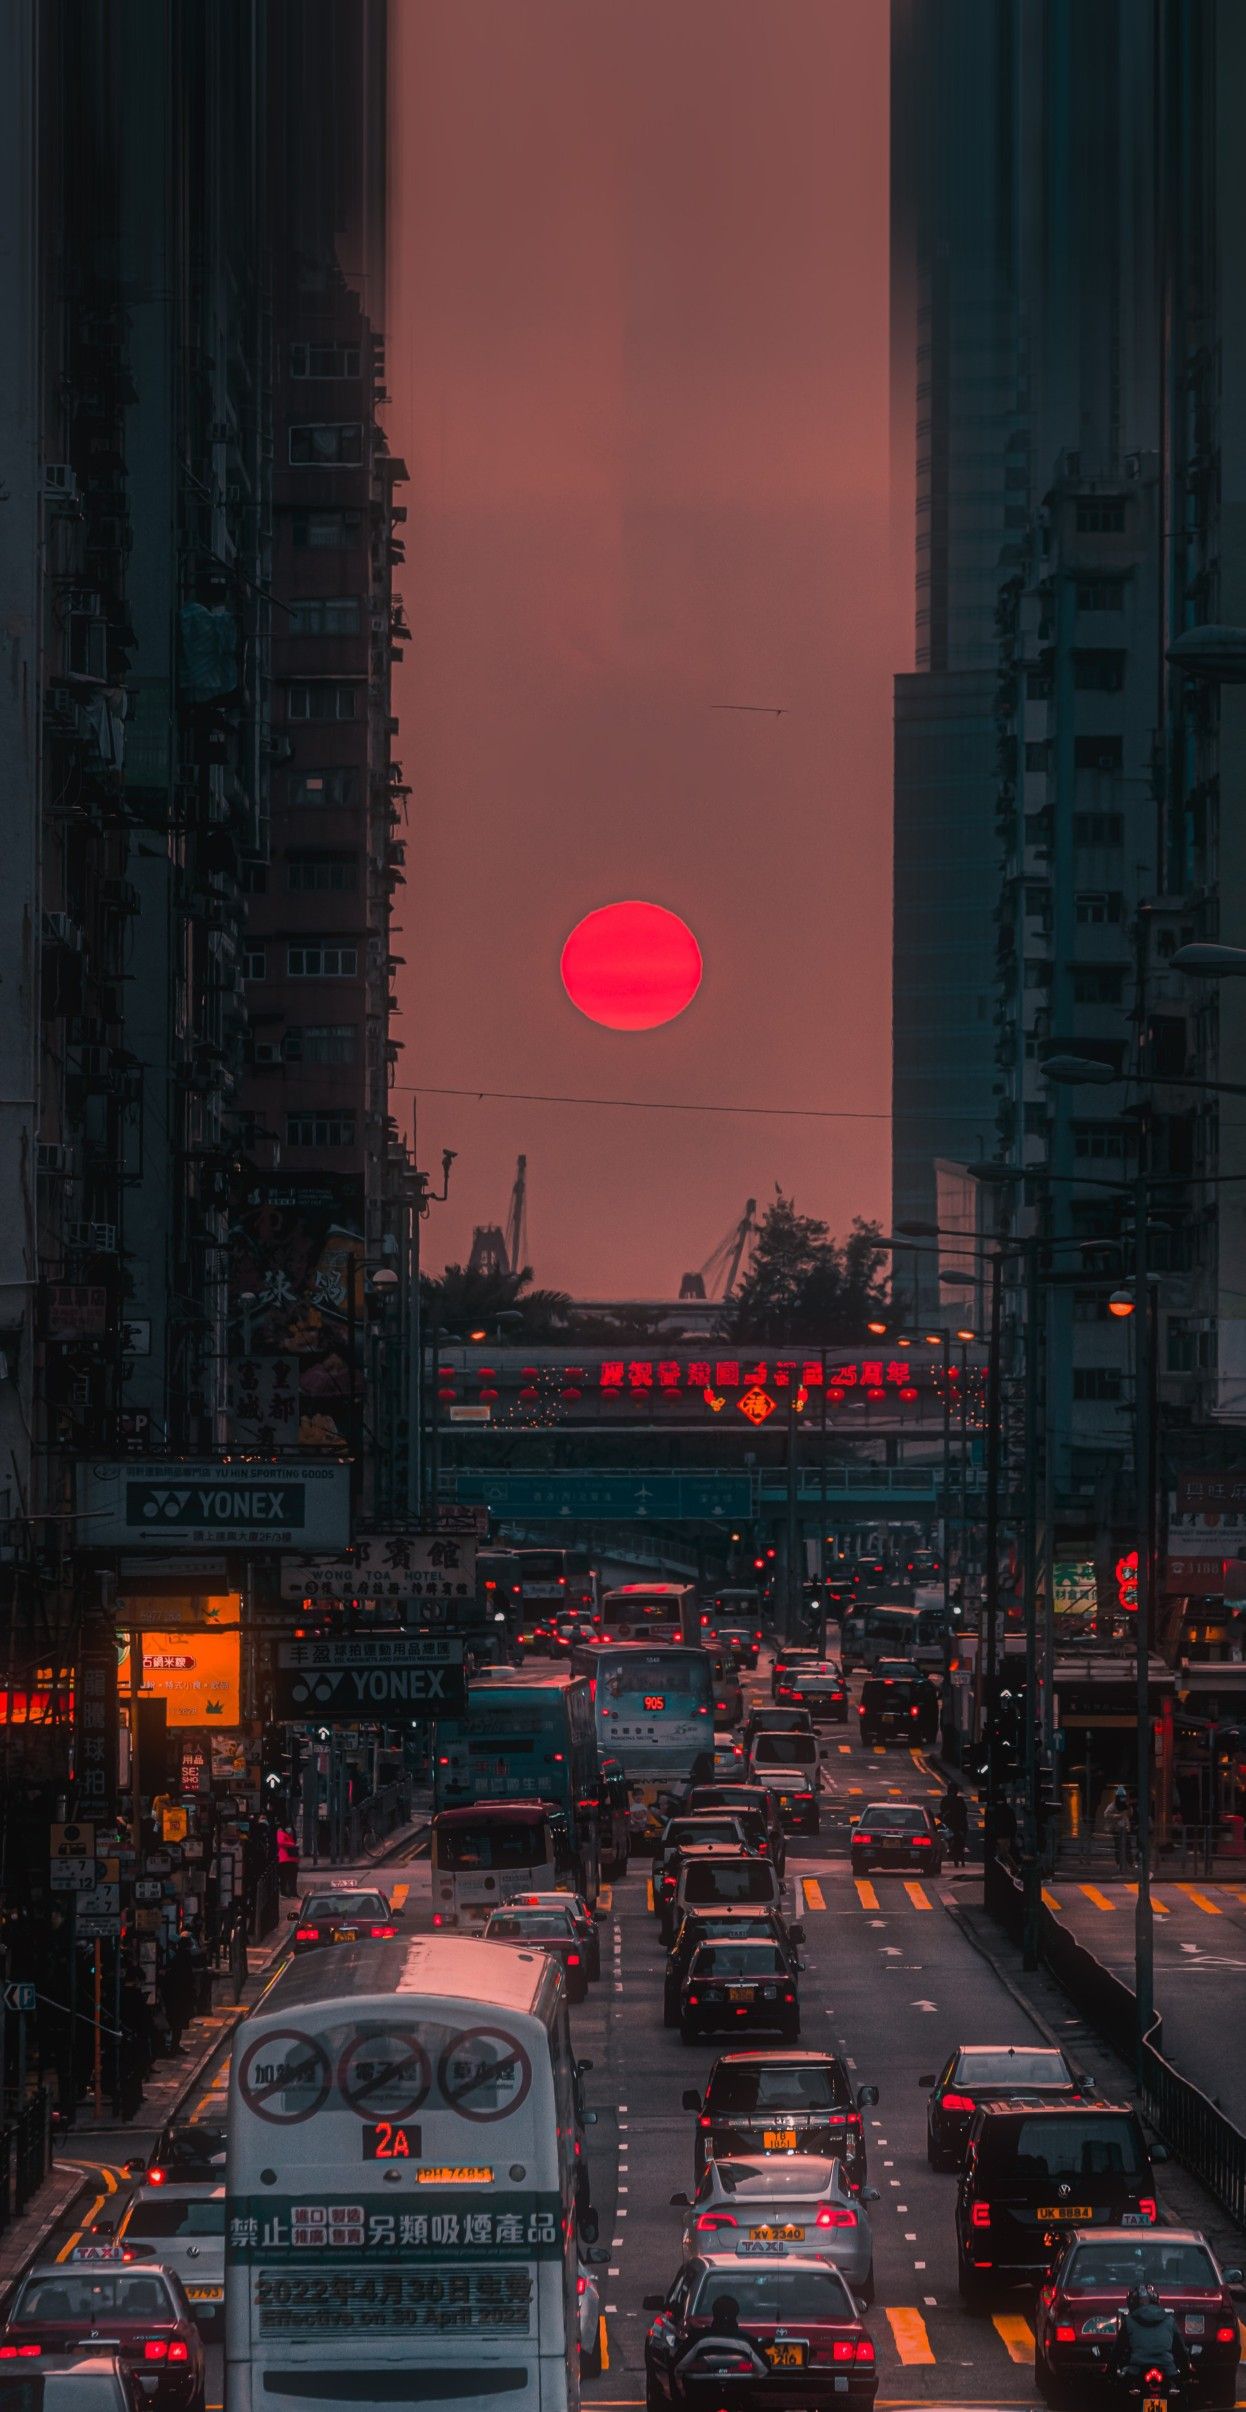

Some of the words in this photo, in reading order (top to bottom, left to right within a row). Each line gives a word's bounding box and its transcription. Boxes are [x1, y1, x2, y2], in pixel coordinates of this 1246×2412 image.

[250, 1469, 299, 1479] SPORTING
[301, 1470, 335, 1479] GOODS
[199, 1490, 285, 1519] YONEX
[312, 1571, 353, 1581] WONG
[366, 1571, 391, 1581] TOA
[404, 1571, 446, 1581] HOTEL
[352, 1669, 446, 1700] YONEX
[644, 1697, 664, 1710] 905
[182, 1754, 204, 1765] 用品
[78, 1861, 86, 1871] 7
[79, 1878, 93, 1889] 12
[103, 1886, 112, 1896] 7
[103, 1902, 112, 1912] 7
[375, 2122, 411, 2159] 2A
[1039, 2207, 1056, 2218] UK
[1124, 2215, 1149, 2225] TAXI
[230, 2216, 290, 2247] 禁止
[369, 2213, 556, 2246] 另類吸煙產品
[754, 2229, 769, 2239] XV
[771, 2228, 802, 2239] 2340
[742, 2241, 785, 2252] TAXI
[77, 2248, 120, 2259] TAXI
